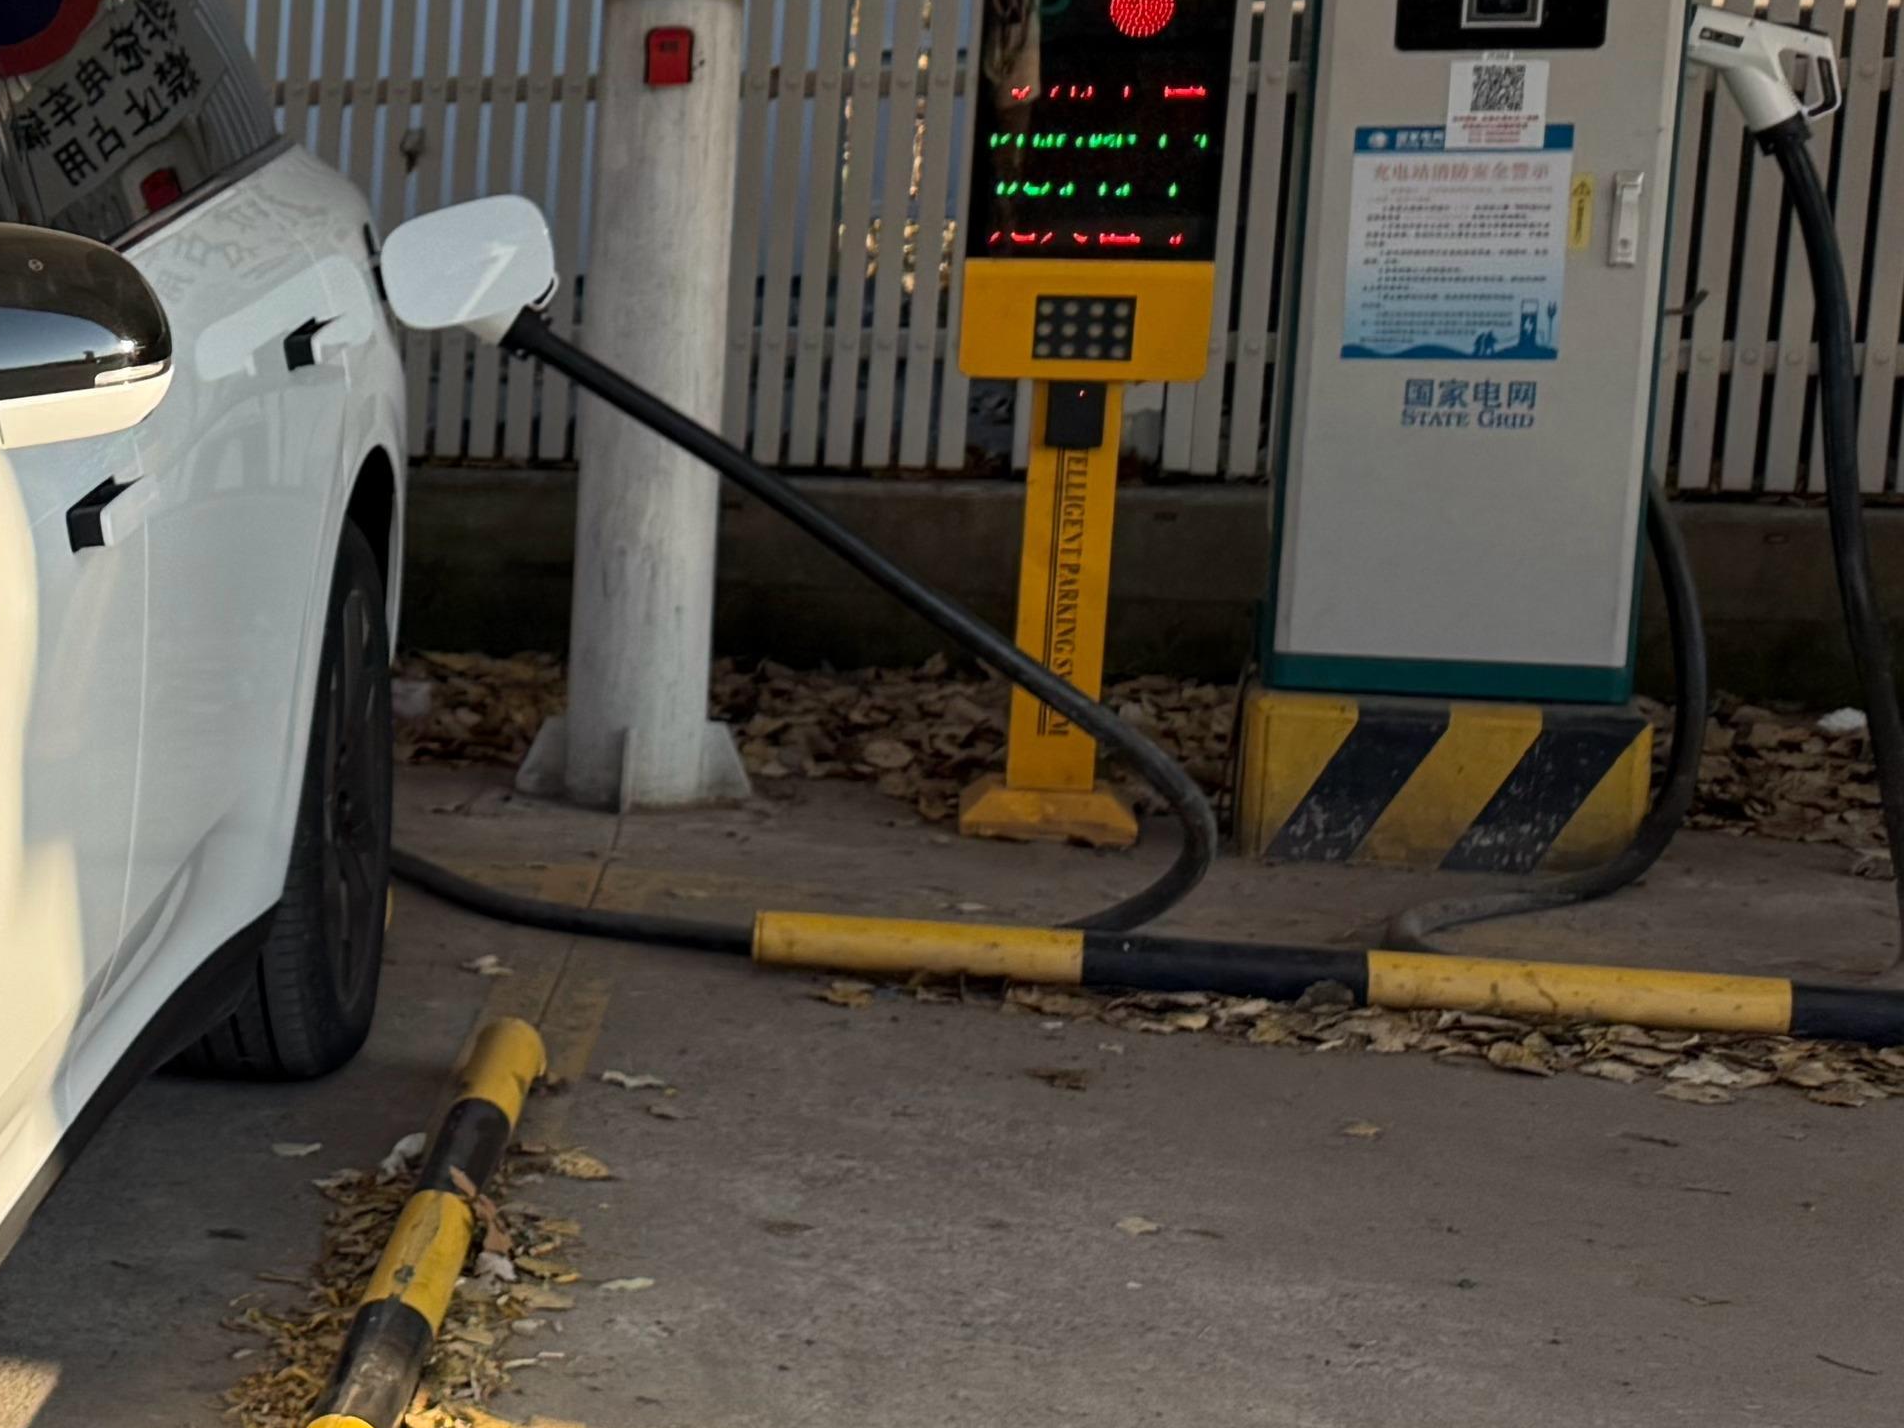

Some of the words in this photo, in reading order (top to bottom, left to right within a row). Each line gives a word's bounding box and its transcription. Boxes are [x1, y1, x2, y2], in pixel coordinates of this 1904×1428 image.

[1404, 378, 1537, 410] 国家电网
[1401, 408, 1471, 428] STATE
[1054, 563, 1082, 654] PARKING
